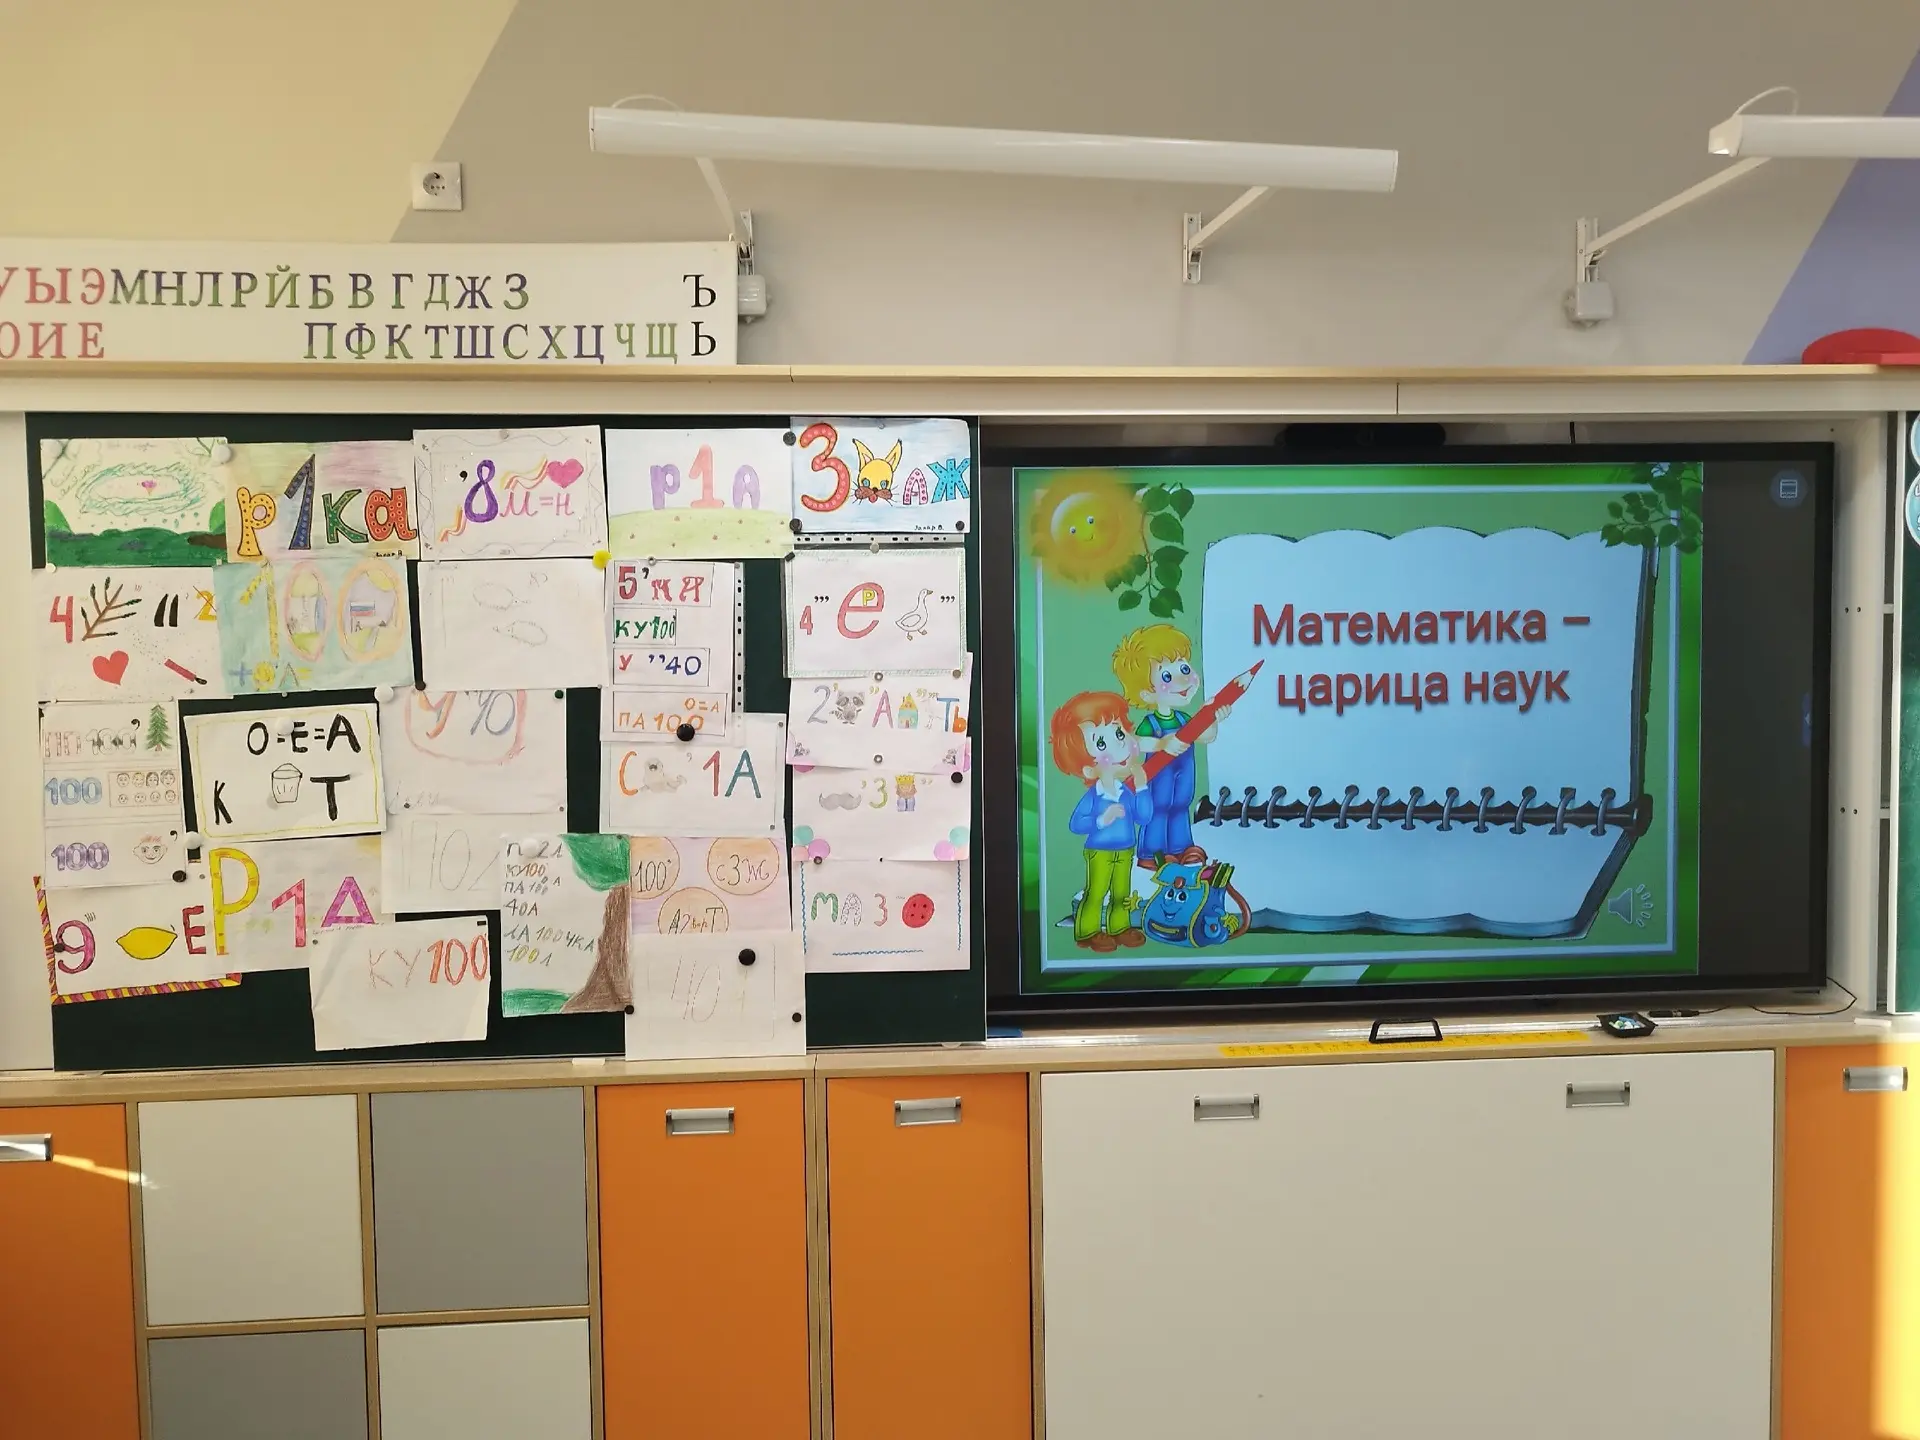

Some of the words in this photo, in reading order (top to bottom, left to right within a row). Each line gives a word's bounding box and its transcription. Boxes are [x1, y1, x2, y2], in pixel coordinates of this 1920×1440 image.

[1253, 603, 1548, 646] Математика
[1278, 671, 1449, 716] царица
[1464, 669, 1571, 712] наук
